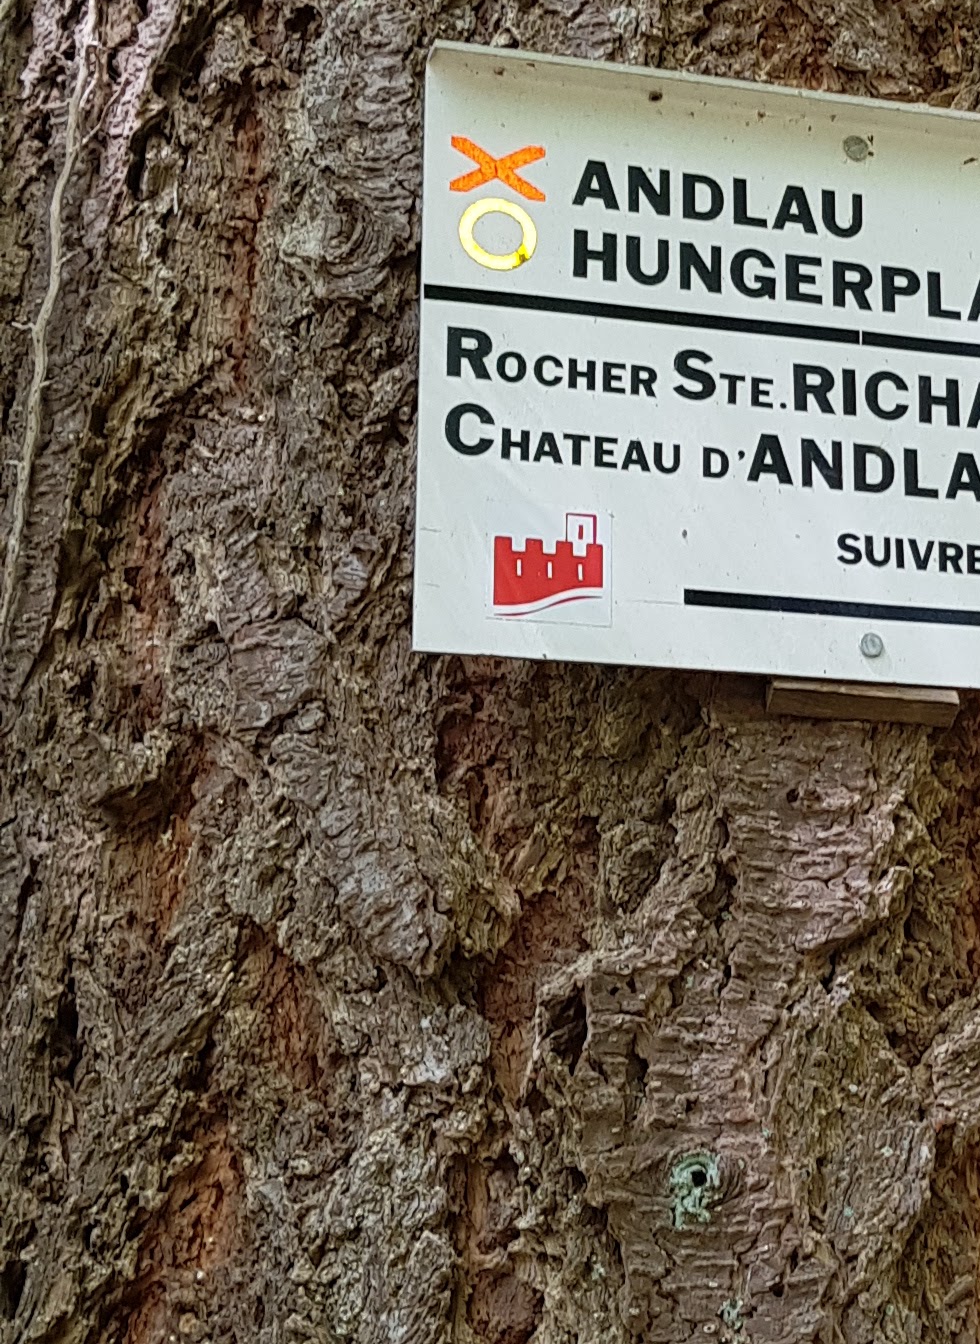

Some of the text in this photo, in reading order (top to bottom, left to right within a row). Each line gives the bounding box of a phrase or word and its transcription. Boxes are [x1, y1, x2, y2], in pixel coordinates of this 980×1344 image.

[571, 159, 863, 239] ANDLAU
[446, 326, 658, 398] ROCHER
[444, 402, 681, 475] CHATEAU
